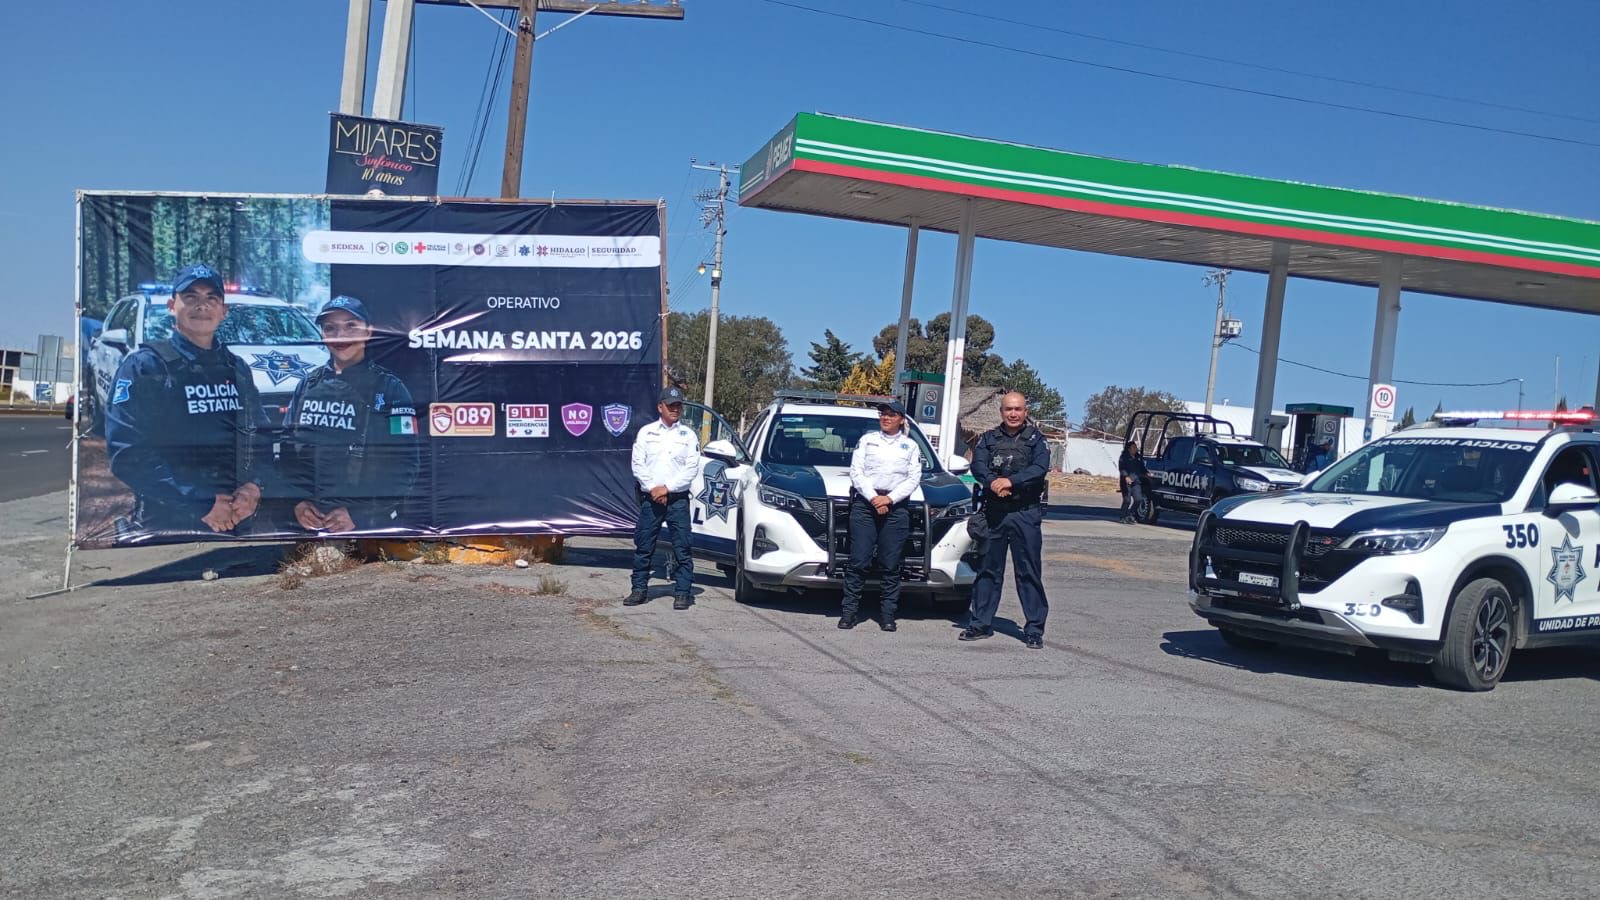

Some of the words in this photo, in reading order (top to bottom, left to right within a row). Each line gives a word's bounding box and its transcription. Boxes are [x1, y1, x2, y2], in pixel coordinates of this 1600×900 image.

[336, 121, 437, 161] MIJARES
[361, 167, 375, 181] 10
[375, 172, 405, 186] años
[331, 243, 365, 251] SEDENA
[487, 296, 561, 309] OPERATIVO
[408, 329, 506, 350] SEMANA
[511, 331, 586, 350] SANTA
[591, 331, 643, 350] 2026
[184, 380, 239, 399] POLICÍA
[1379, 392, 1389, 402] 10
[187, 398, 243, 414] ESTATAL
[511, 407, 545, 417] 911
[568, 409, 588, 420] NO
[300, 413, 357, 431] ESTATAL
[455, 407, 491, 425] 089
[1162, 470, 1200, 489] POLICÍA
[1502, 523, 1538, 549] 350
[1539, 619, 1573, 631] UNIDAD
[1574, 617, 1587, 627] DE
